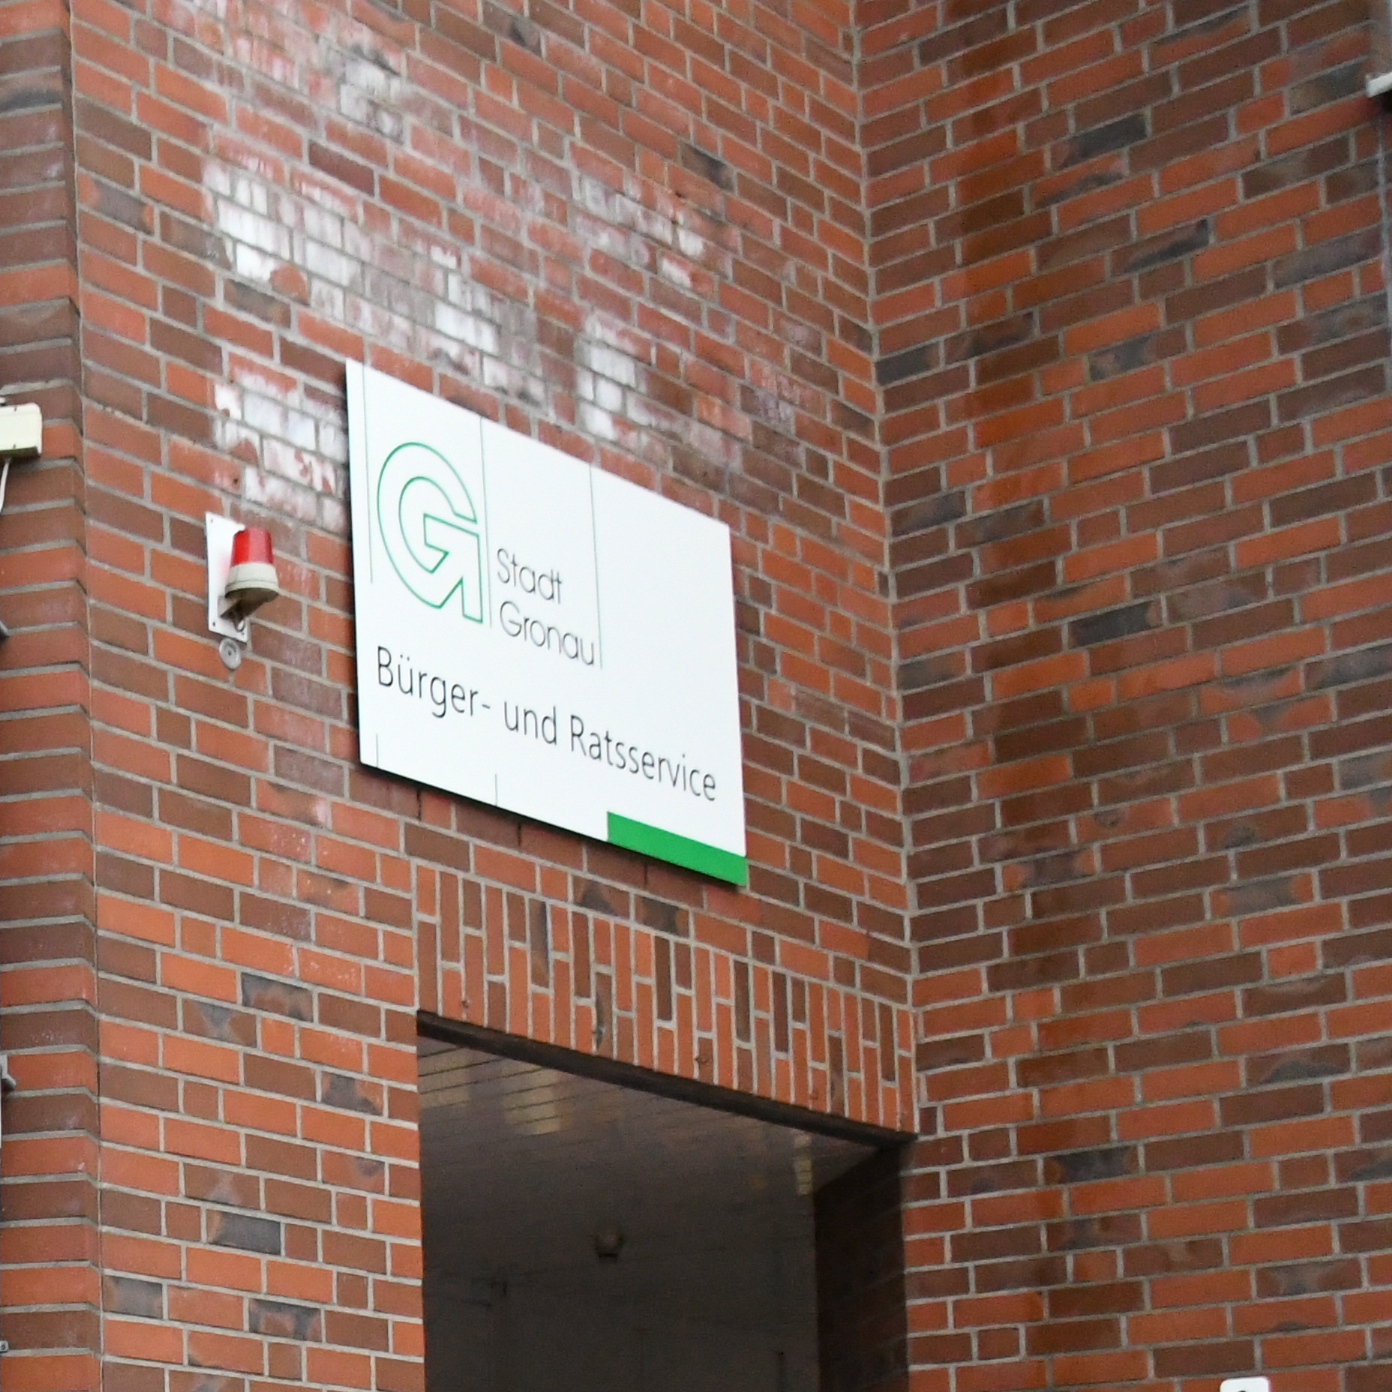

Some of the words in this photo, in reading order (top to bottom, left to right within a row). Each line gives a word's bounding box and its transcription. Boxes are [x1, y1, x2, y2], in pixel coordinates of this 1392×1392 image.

[497, 547, 563, 605] Stadt
[499, 600, 597, 667] Gronau
[377, 645, 492, 719] Bürger-
[503, 697, 558, 745] und
[570, 713, 718, 802] Ratsservice
